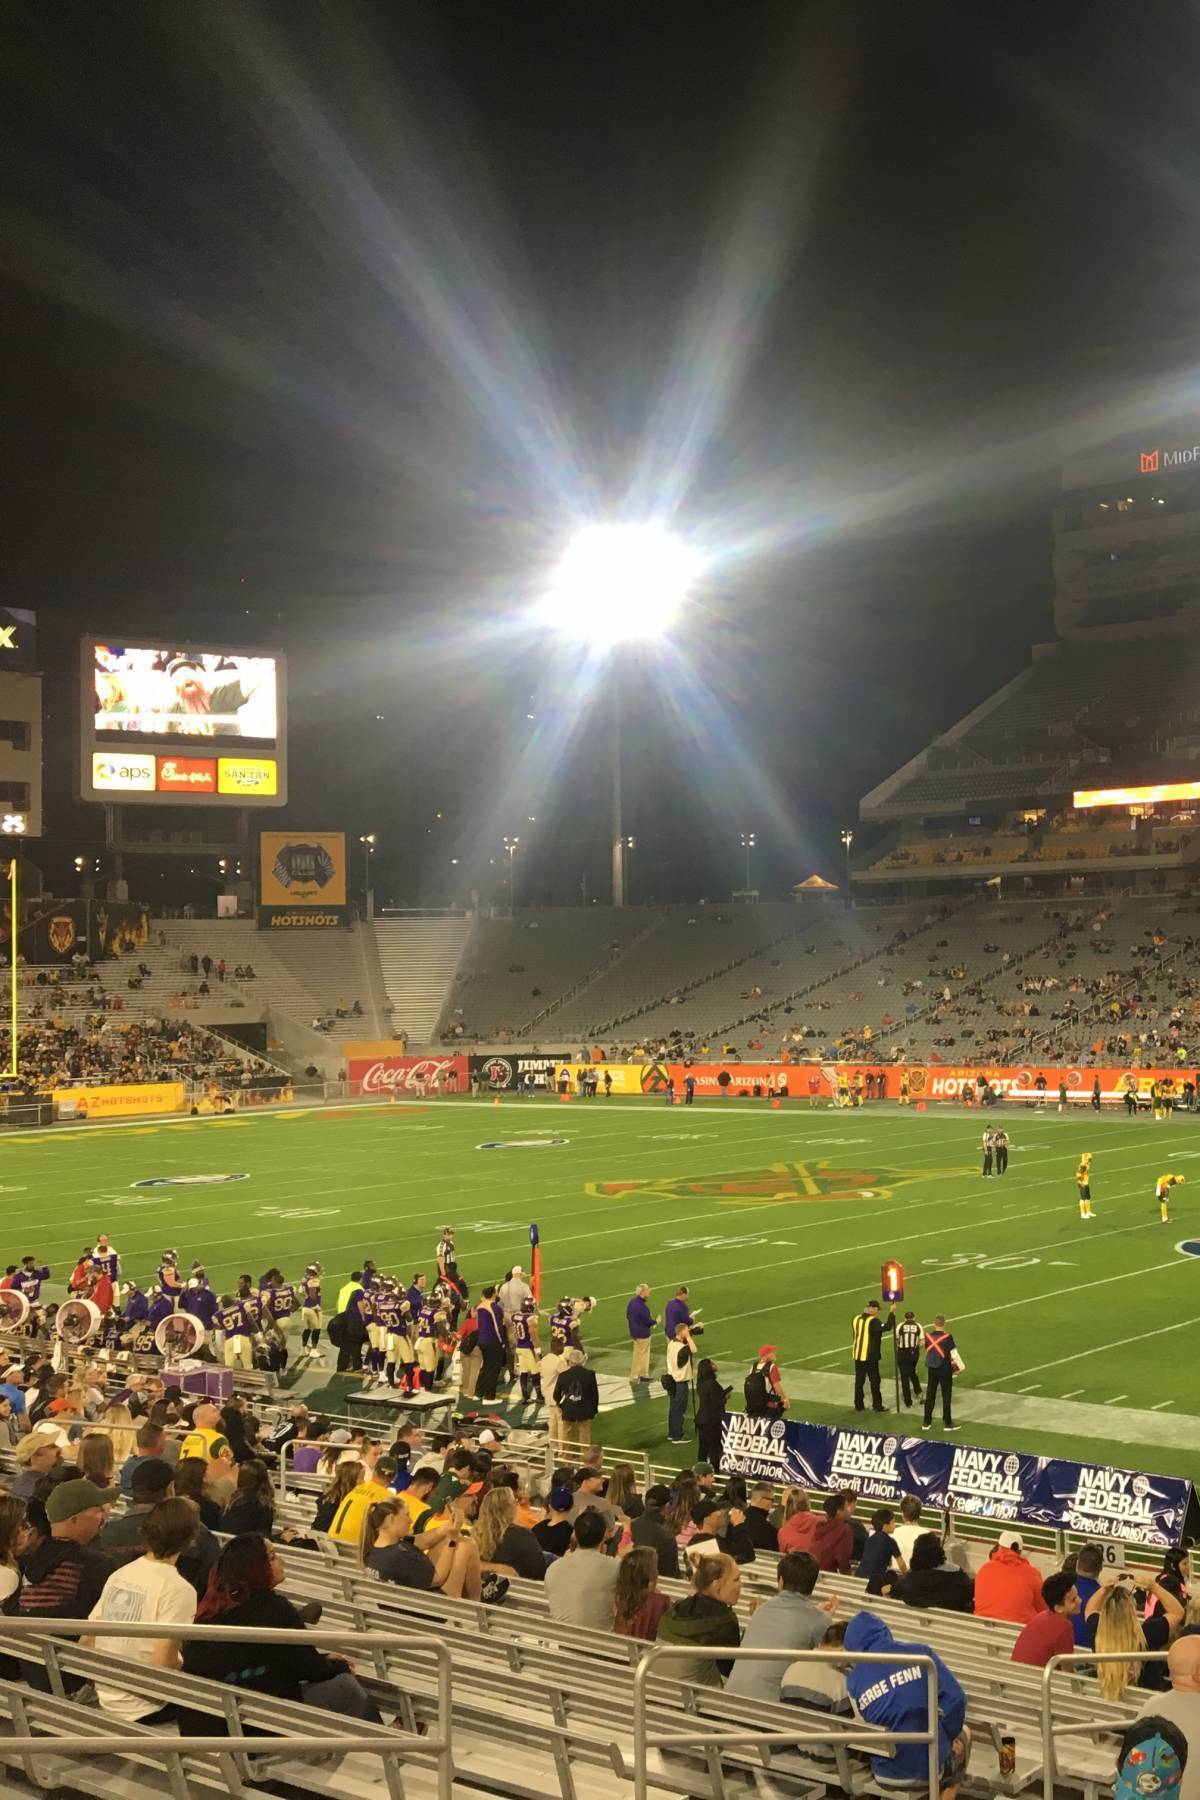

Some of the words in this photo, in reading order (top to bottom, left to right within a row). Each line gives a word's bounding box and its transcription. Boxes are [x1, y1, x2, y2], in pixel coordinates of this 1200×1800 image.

[119, 766, 150, 781] aps
[271, 914, 340, 927] HOTSHOTS
[101, 1094, 163, 1106] HOTSHOTS
[920, 1253, 1042, 1270] 30
[888, 1266, 898, 1292] 1
[222, 1311, 244, 1331] 97
[729, 1415, 770, 1438] NAVY
[726, 1433, 788, 1458] FEDERAL
[836, 1432, 882, 1454] NAVY
[719, 1454, 750, 1474] Credit
[750, 1460, 784, 1479] Union
[831, 1451, 898, 1476] FEDERAL
[953, 1448, 1002, 1473] NAVY
[827, 1473, 862, 1492] Credit
[862, 1479, 896, 1498] Union
[949, 1467, 1022, 1496] FEDERAL
[1079, 1467, 1131, 1492] NAVY
[944, 1491, 984, 1513] Credit
[984, 1498, 1018, 1519] Union
[1074, 1487, 1152, 1517] FEDERAL
[1070, 1514, 1109, 1535] Credit
[1111, 1520, 1150, 1542] Union
[889, 1665, 922, 1689] FENN
